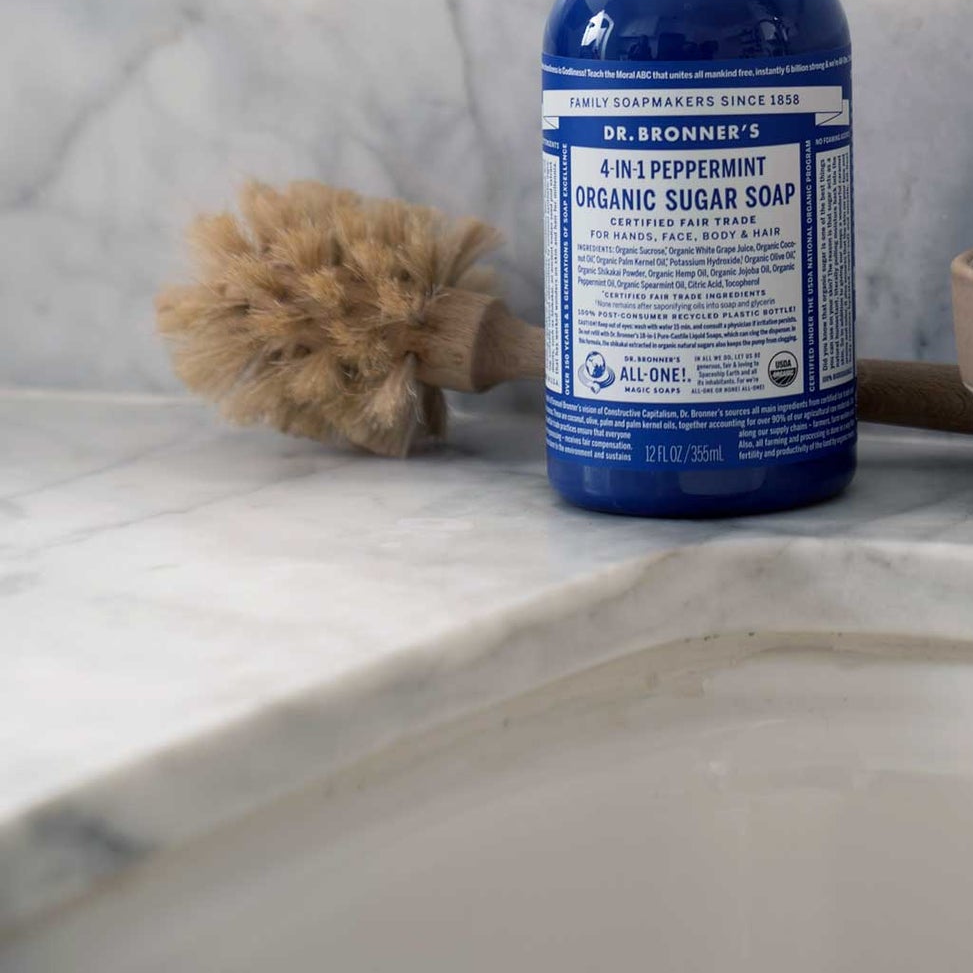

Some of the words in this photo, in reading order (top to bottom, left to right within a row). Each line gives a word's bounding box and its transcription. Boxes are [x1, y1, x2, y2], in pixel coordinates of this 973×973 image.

[587, 69, 604, 77] Teach
[605, 70, 616, 78] the
[616, 70, 635, 79] Moral
[636, 71, 652, 79] ABC
[694, 71, 703, 79] all
[705, 70, 737, 79] mankind
[738, 69, 755, 78] free,
[756, 66, 785, 77] instantly
[786, 65, 791, 73] 6
[791, 63, 809, 73] billion
[570, 97, 609, 108] FAMILY
[614, 96, 714, 107] SOAPMAKERS
[721, 95, 765, 106] SINCE
[770, 94, 800, 105] 1858
[604, 126, 634, 141] DR.
[638, 123, 760, 141] BRONNER'S
[600, 159, 645, 179] 4-IN-1
[651, 156, 766, 179] PEPPERMINT
[576, 185, 656, 211] ORGANIC
[665, 187, 737, 211] SUGAR
[745, 182, 795, 208] SOAP
[610, 217, 674, 227] CERTIFIED
[680, 218, 709, 227] FAIR
[714, 215, 757, 227] TRADE
[563, 228, 568, 238] OF
[591, 230, 609, 239] FOR
[613, 231, 658, 242] HANDS,
[662, 232, 697, 242] FACE,
[703, 230, 735, 241] BODY
[741, 229, 749, 239] &
[753, 227, 780, 238] HAIR
[616, 246, 638, 256] Organic
[669, 247, 695, 256] Organic
[695, 246, 715, 254] White
[716, 245, 736, 255] Grape
[737, 244, 755, 253] Juice,
[756, 241, 779, 253] Organic
[780, 239, 796, 249] Coco-
[596, 256, 617, 267] Organic
[619, 257, 633, 266] Palm
[634, 258, 655, 266] Kernel
[670, 258, 705, 266] Potassium
[744, 254, 769, 265] Organic
[770, 252, 785, 261] Olive
[598, 267, 621, 276] Shikakai
[622, 269, 647, 278] Powder,
[648, 270, 674, 279] Organic
[675, 270, 696, 279] Hemp
[697, 269, 709, 278] Oil,
[710, 268, 736, 278] Organic
[738, 266, 759, 277] Jojoba
[761, 265, 771, 274] Oil,
[772, 263, 795, 274] Organic
[578, 276, 606, 288] Peppermint
[607, 279, 616, 288] Oil,
[617, 280, 639, 290] Organic
[641, 281, 674, 291] Spearmint
[675, 281, 687, 290] Oil,
[687, 281, 706, 289] Citric
[707, 280, 724, 289] Acid,
[725, 278, 760, 289] Tocopherol
[706, 290, 766, 300] INGREDIENTS
[598, 310, 668, 320] POST-CONSUMER
[672, 312, 719, 320] RECYCLED
[722, 309, 760, 318] PLASTIC
[763, 306, 796, 316] BOTTLE!
[637, 302, 652, 310] after
[653, 303, 692, 312] saponifying
[693, 302, 705, 310] oils
[721, 302, 736, 310] soap
[737, 300, 749, 308] and
[751, 299, 775, 309] glycerin
[775, 359, 792, 369] USDA
[620, 367, 686, 382] ALL-ONE!
[604, 407, 641, 417] Constructive
[642, 410, 679, 420] Capitalism,
[691, 409, 723, 418] Bronner's
[725, 408, 750, 416] sources
[751, 405, 760, 414] all
[761, 405, 777, 414] main
[777, 400, 808, 413] ingredients
[600, 418, 613, 428] palm
[614, 419, 625, 428] and
[626, 420, 641, 430] palm
[642, 421, 662, 429] kernel
[663, 422, 678, 430] oils,
[679, 421, 708, 431] together
[709, 419, 745, 431] accounting
[747, 417, 756, 426] for
[757, 417, 770, 425] over
[771, 413, 786, 424] 90%
[787, 413, 793, 421] of
[794, 412, 803, 420] our
[594, 428, 605, 437] that
[605, 431, 631, 441] everyone
[739, 428, 756, 439] along
[758, 428, 768, 436] our
[770, 425, 789, 436] supply
[790, 421, 807, 432] chains
[592, 438, 632, 452] compensation.
[739, 440, 754, 450] Also,
[755, 439, 763, 447] all
[765, 435, 787, 448] farming
[789, 434, 799, 443] and
[594, 451, 604, 460] and
[606, 452, 631, 461] sustains
[646, 445, 656, 462] 12
[657, 445, 669, 462] FL
[739, 450, 763, 461] fertility
[764, 449, 775, 457] and
[776, 443, 809, 458] productivity
